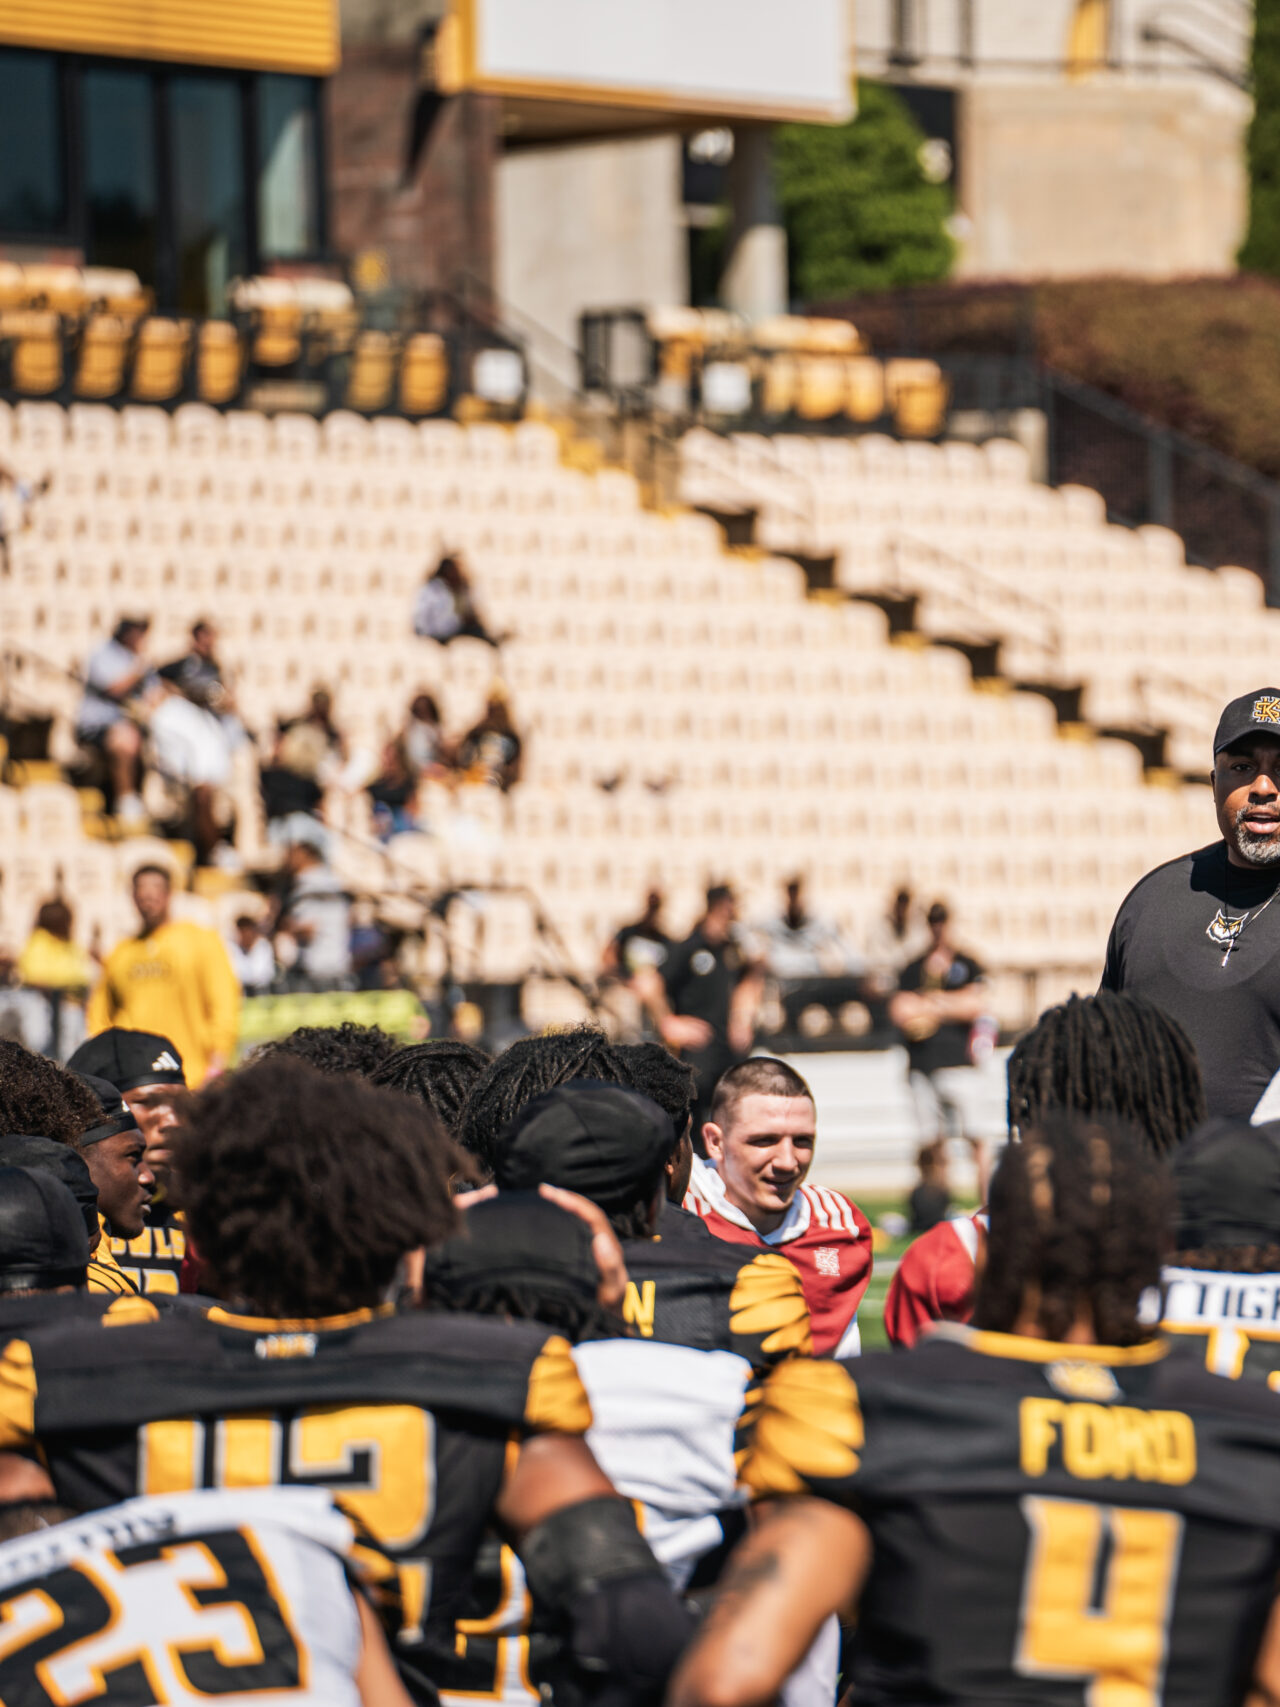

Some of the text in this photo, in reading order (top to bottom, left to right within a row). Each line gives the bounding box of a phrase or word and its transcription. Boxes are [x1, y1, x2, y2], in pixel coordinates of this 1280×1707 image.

[1019, 1396, 1198, 1486] FORD
[0, 1523, 312, 1707] 23
[1011, 1493, 1187, 1707] 4
